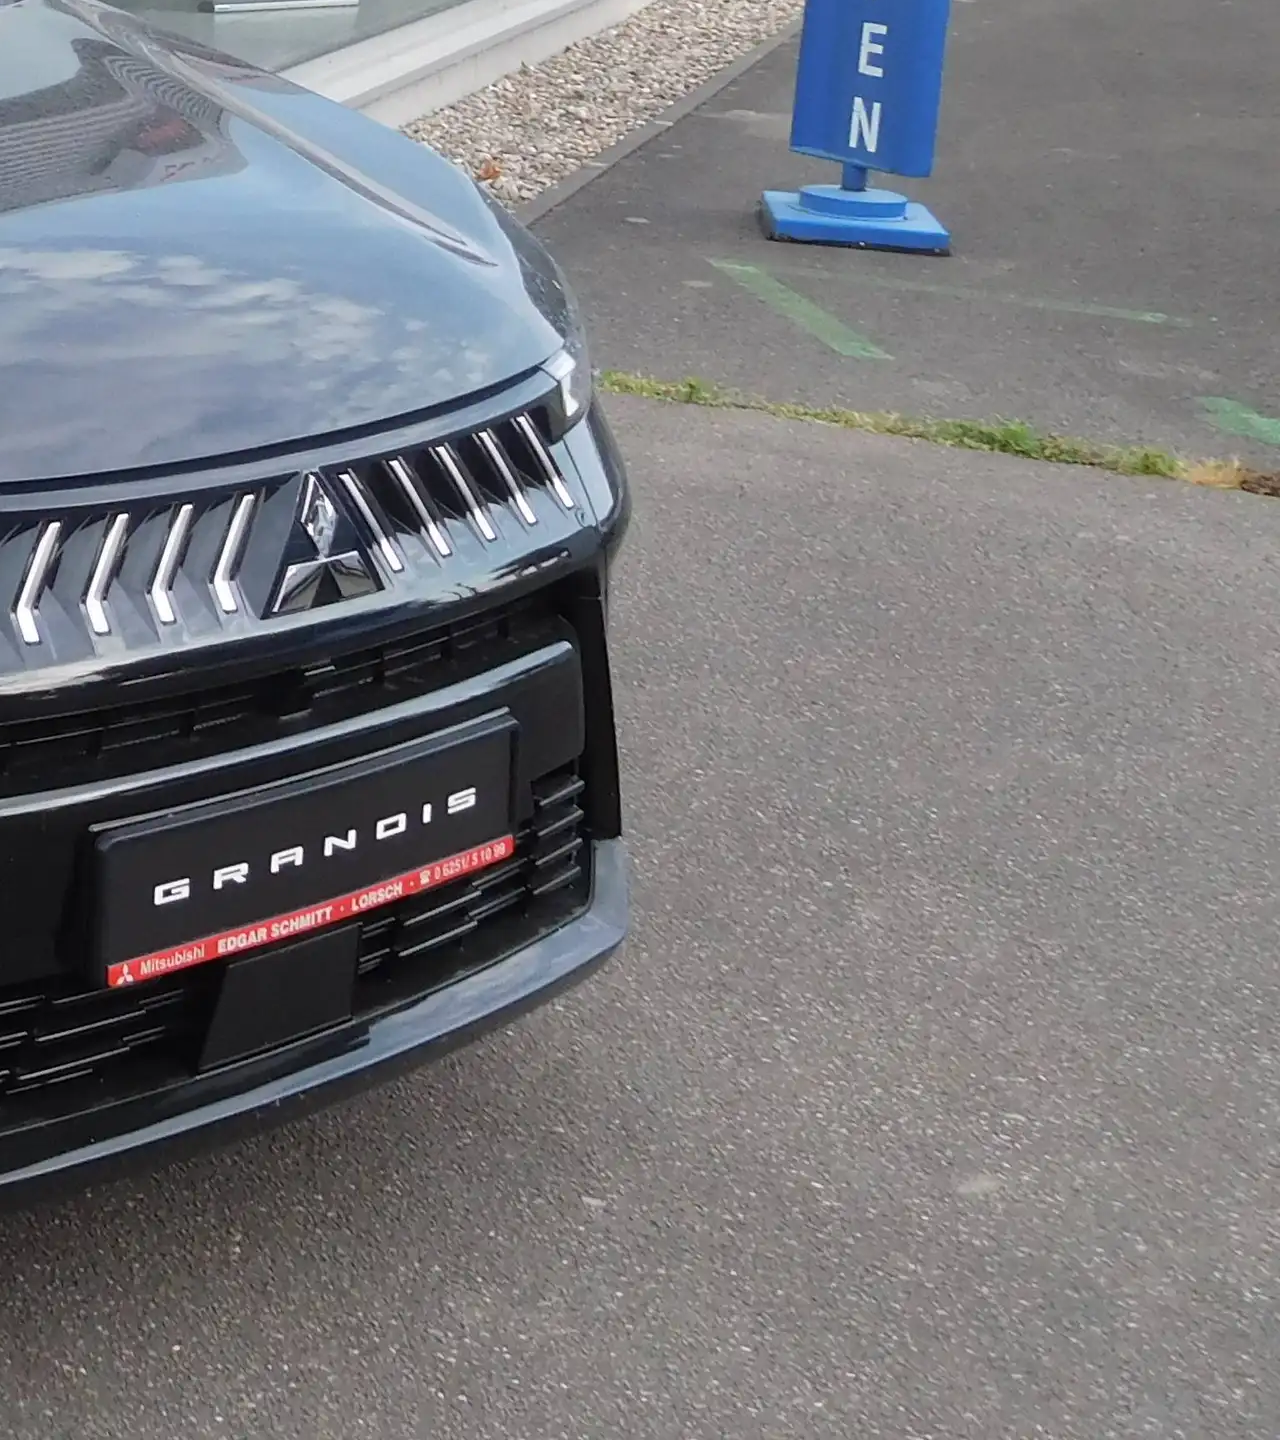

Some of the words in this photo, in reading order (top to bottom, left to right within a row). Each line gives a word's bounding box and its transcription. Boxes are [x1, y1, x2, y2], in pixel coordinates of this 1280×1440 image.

[151, 785, 477, 906] GRANDIS
[139, 943, 205, 976] Mitsubishi
[217, 927, 268, 954] EDGAR
[271, 905, 333, 938] SCHMITT
[351, 881, 404, 912] LORSCH
